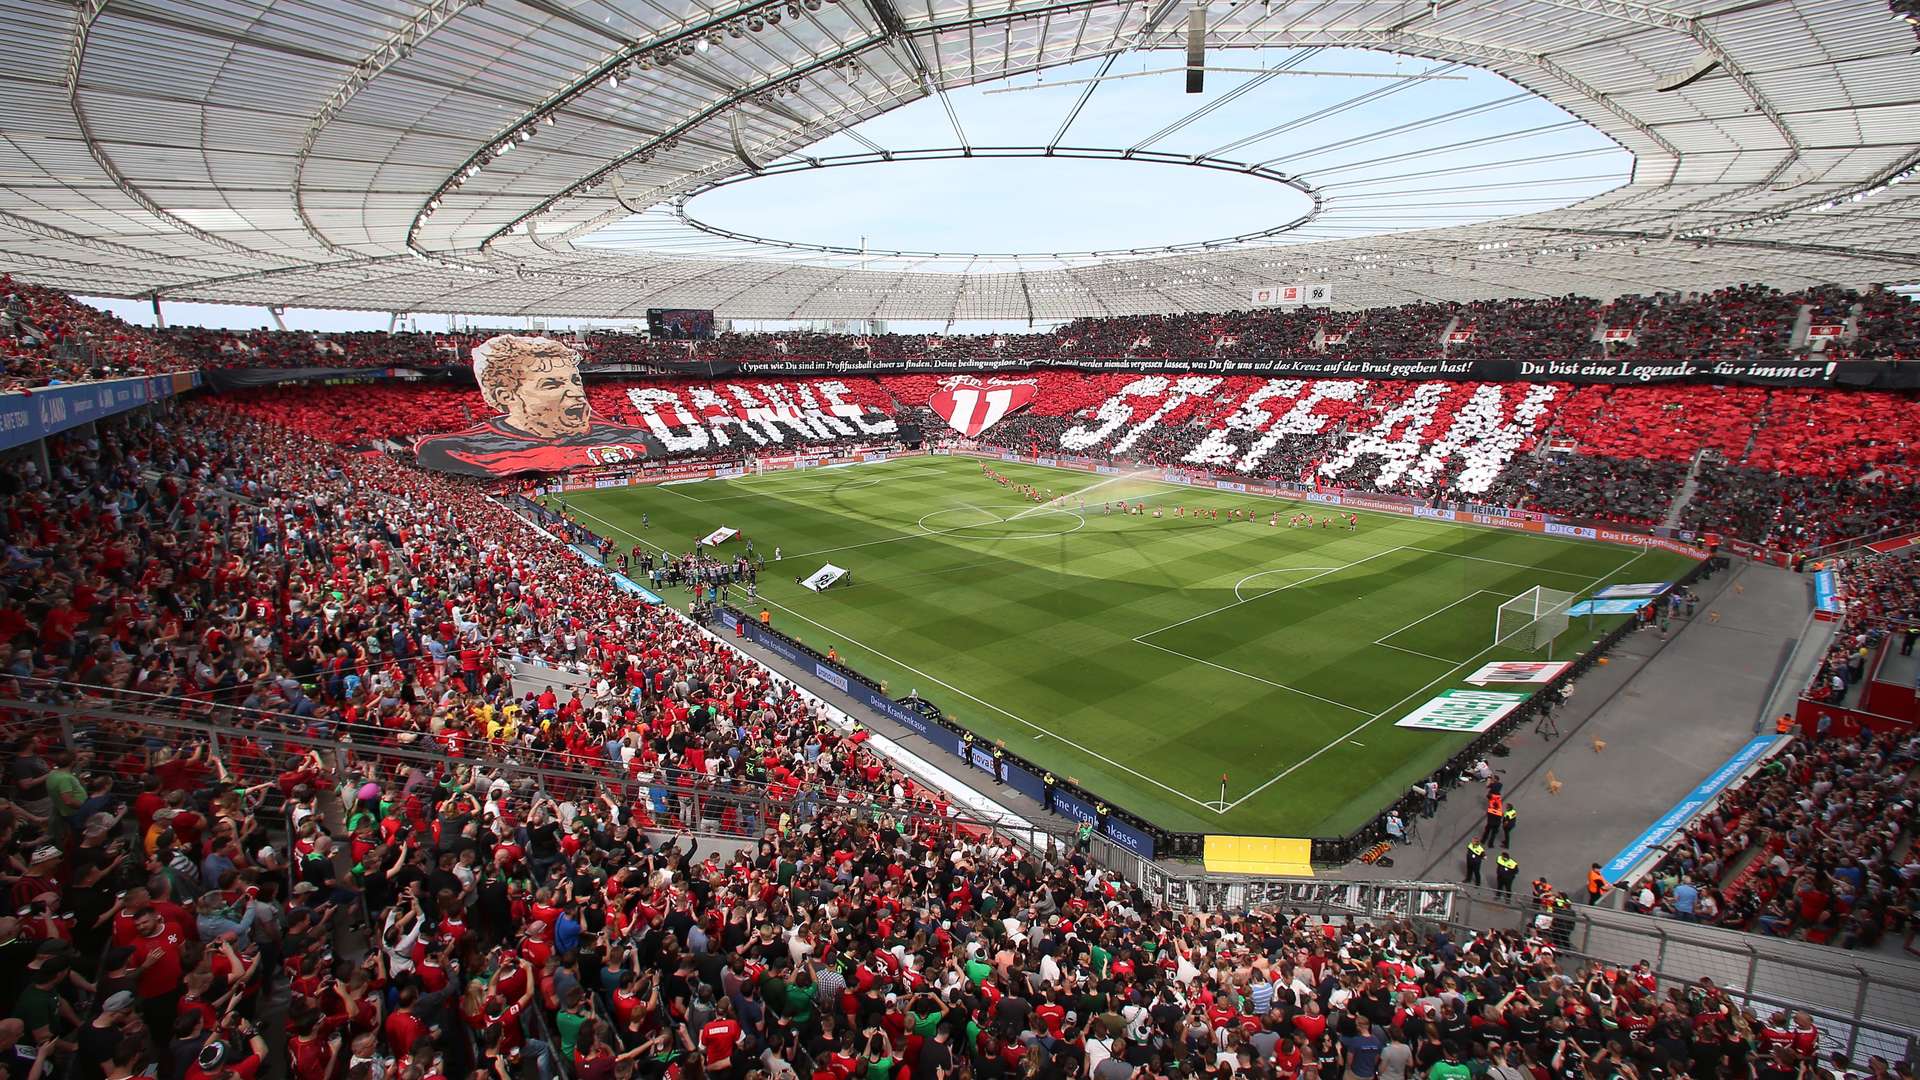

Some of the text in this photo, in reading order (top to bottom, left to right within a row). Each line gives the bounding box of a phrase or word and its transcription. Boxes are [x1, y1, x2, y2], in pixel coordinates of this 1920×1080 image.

[771, 362, 784, 370] wie
[785, 361, 797, 370] Du
[798, 361, 815, 370] sind
[815, 362, 825, 370] im
[827, 360, 872, 372] Profifussball
[934, 359, 957, 369] Deine
[1080, 359, 1104, 368] werden
[1104, 359, 1130, 368] niemals
[1130, 360, 1163, 371] vergessen
[1208, 360, 1221, 370] Du
[1221, 360, 1236, 372] für
[1237, 362, 1252, 370] uns
[1254, 360, 1274, 370] und
[1273, 360, 1290, 371] das
[1291, 361, 1321, 372] Kreuz
[1323, 361, 1343, 374] auf
[1343, 361, 1360, 372] der
[1361, 362, 1391, 373] Brust
[1390, 362, 1436, 376] gegeben
[1440, 361, 1473, 373] hast!
[1520, 361, 1544, 375] Du
[1549, 361, 1579, 375] bist
[1581, 362, 1616, 376] eine
[1618, 361, 1697, 381] Legende
[1712, 361, 1745, 375] für
[626, 381, 899, 452] DANKE
[1059, 375, 1557, 493] STEFAN
[1308, 493, 1339, 503] DITCON
[1416, 507, 1454, 520] DITCON
[1472, 505, 1508, 517] HEIMAT
[1550, 525, 1593, 536] DITCON
[1601, 530, 1618, 540] Das
[870, 695, 927, 733] Deine Krankenkasse
[1072, 803, 1138, 848] Kranknkasse
